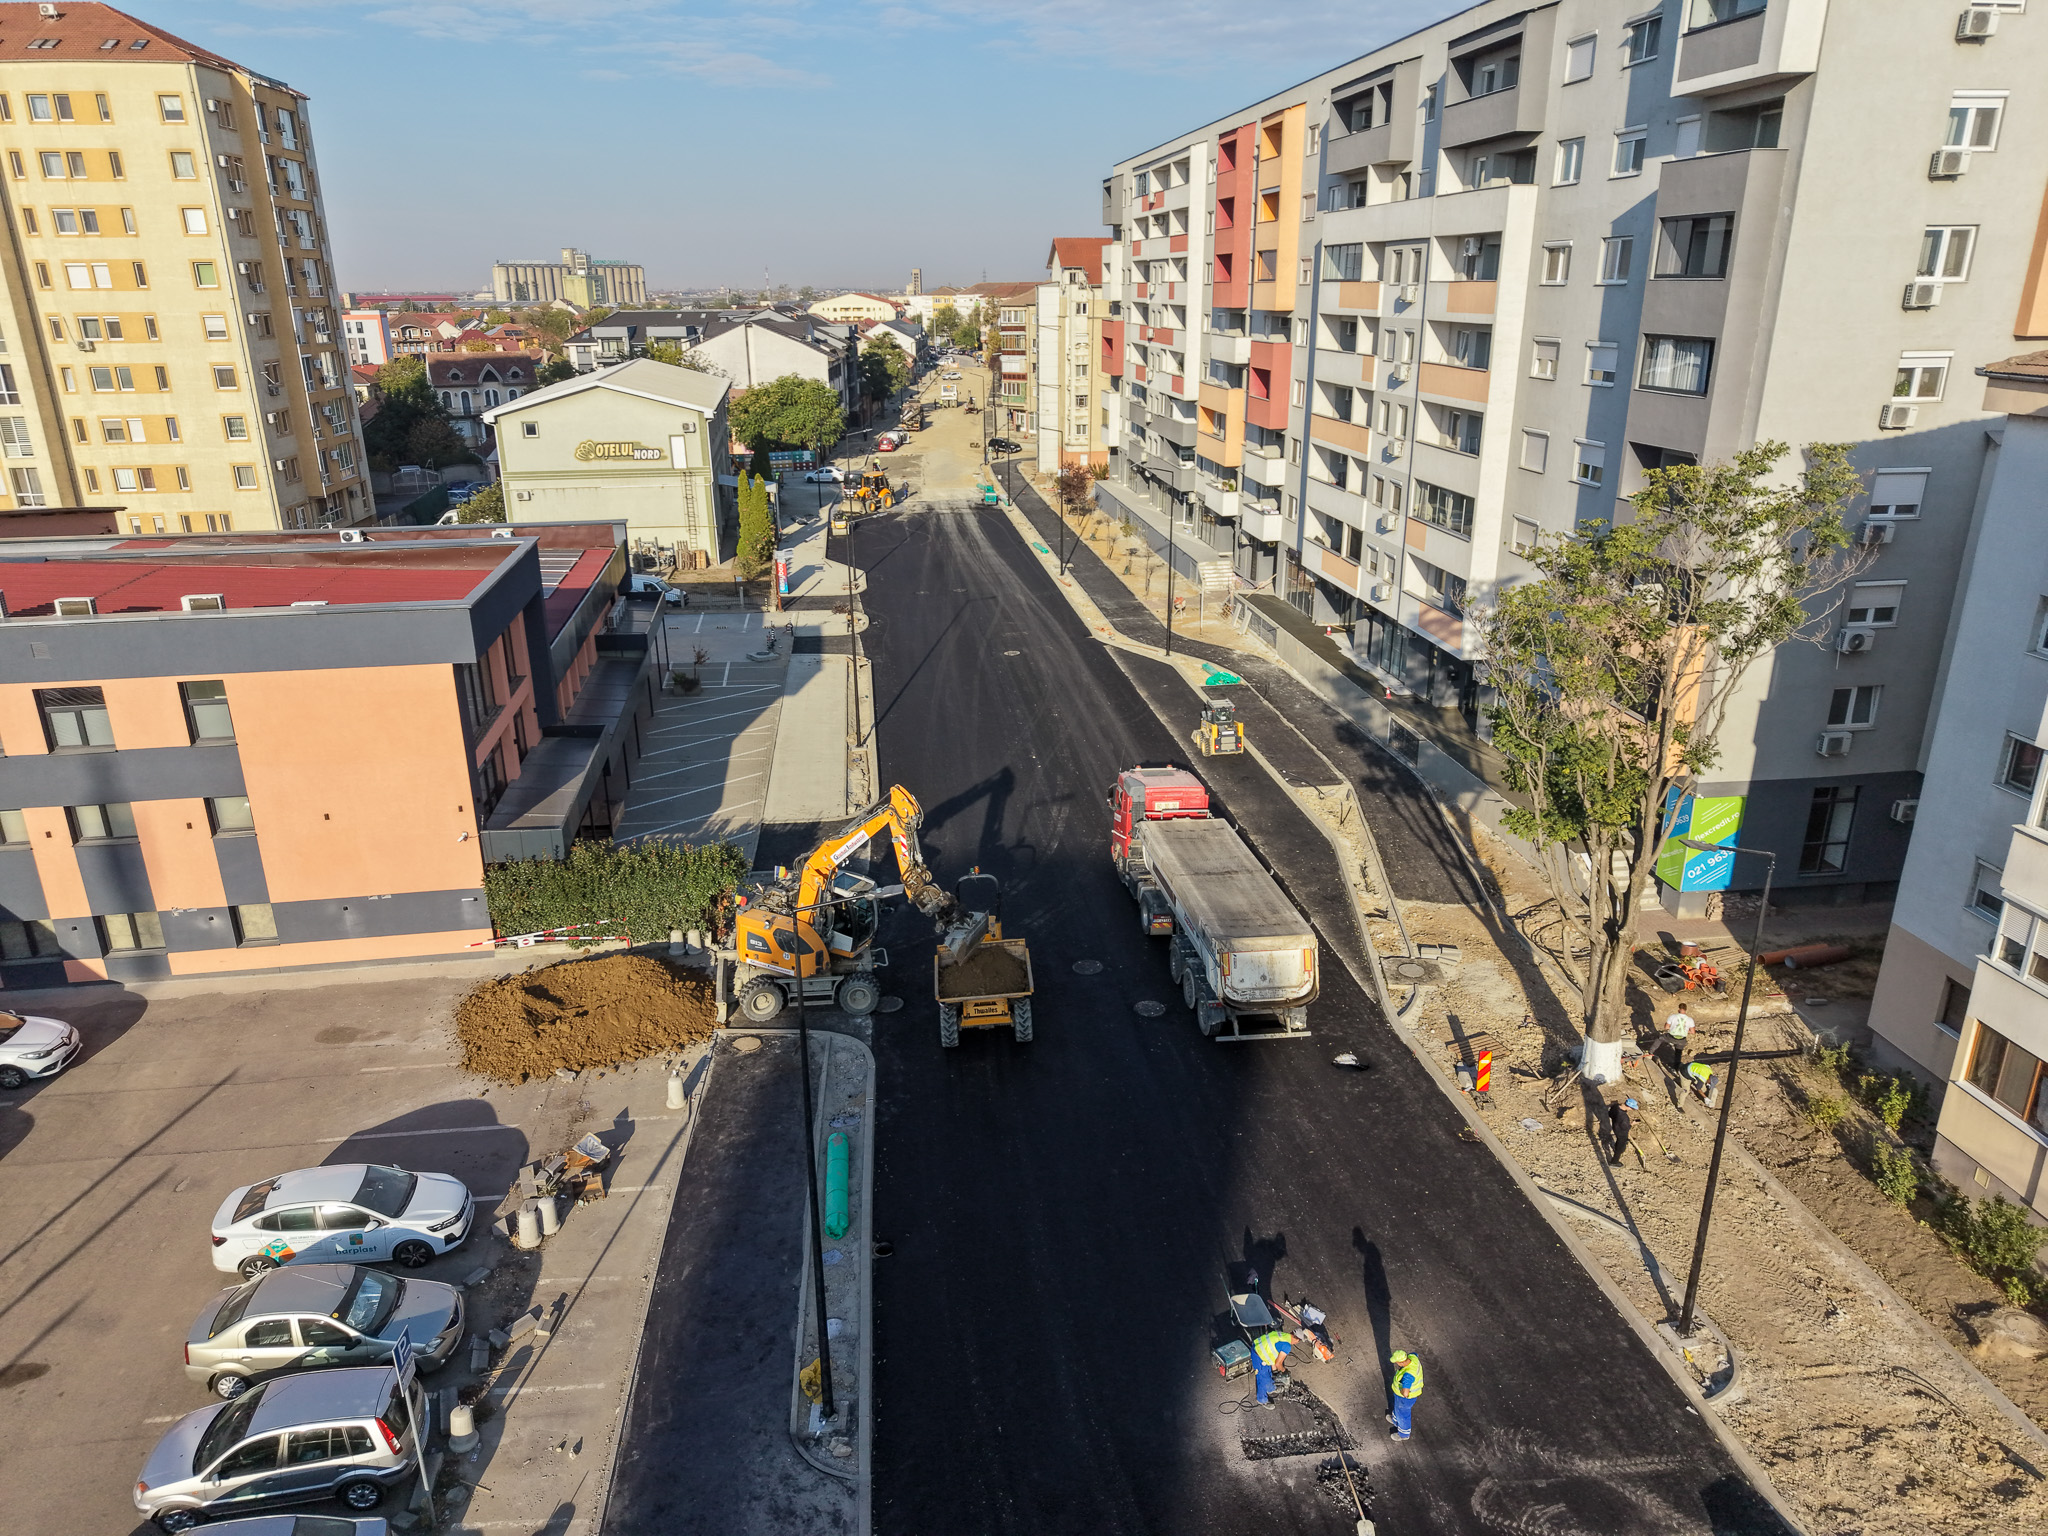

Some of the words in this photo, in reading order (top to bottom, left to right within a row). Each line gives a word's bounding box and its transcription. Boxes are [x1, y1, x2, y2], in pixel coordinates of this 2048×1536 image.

[634, 449, 661, 460] NORD
[1694, 812, 1740, 841] flexcredit.ro
[1687, 863, 1706, 878] 021
